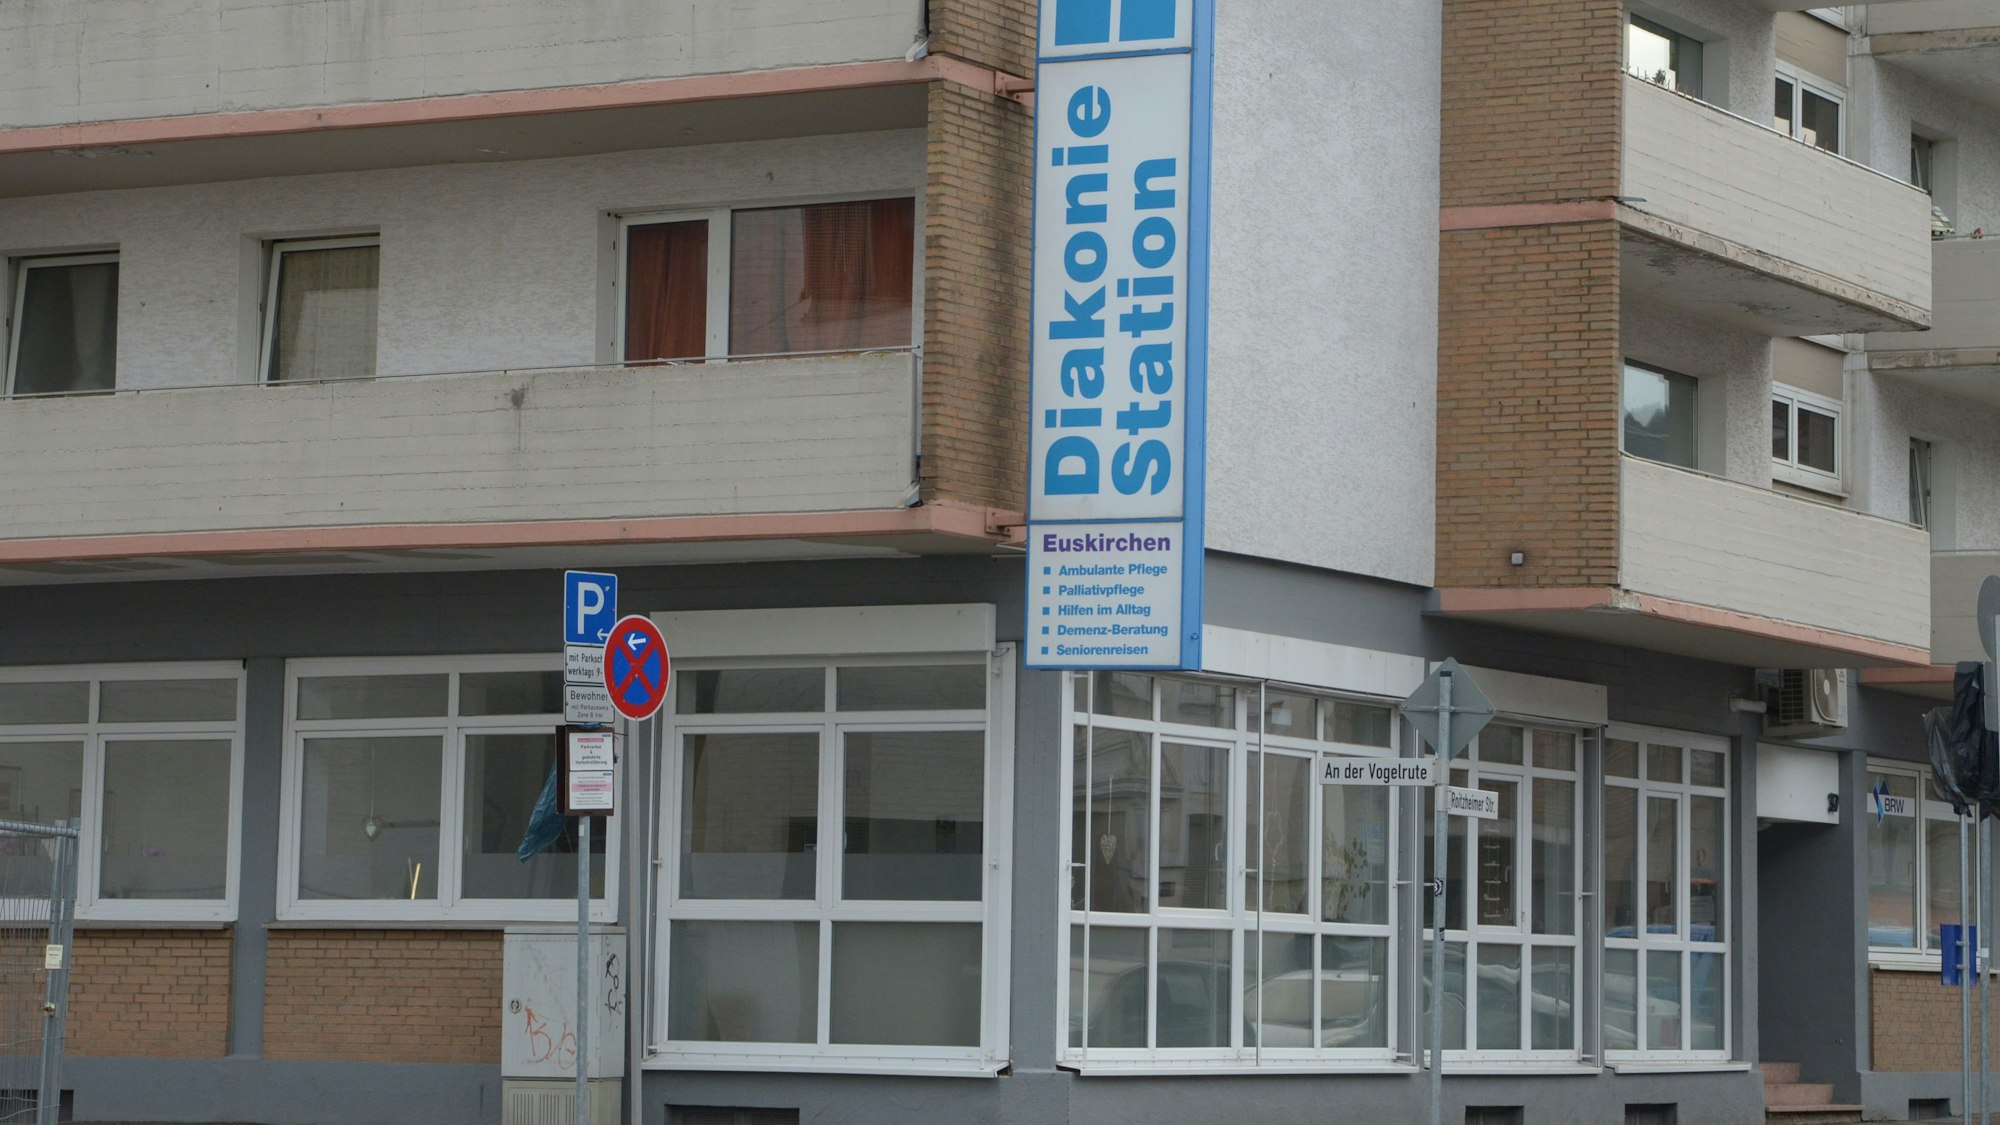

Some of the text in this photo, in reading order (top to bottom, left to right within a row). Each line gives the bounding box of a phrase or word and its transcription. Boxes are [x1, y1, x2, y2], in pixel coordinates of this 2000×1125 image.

[1043, 85, 1112, 496] Diakonie
[1111, 157, 1176, 496] Station
[1043, 533, 1171, 552] Euskirchen
[1058, 564, 1168, 577] Ambulante Pflege
[1058, 584, 1145, 597] Palliativpflege
[578, 582, 604, 634] P
[1058, 603, 1151, 617] Hilfen im Alltag
[1057, 624, 1168, 636] Demenz-Beratung
[1056, 644, 1149, 656] Seniorenreisen
[569, 653, 579, 662] mit
[568, 667, 594, 678] werktags
[1324, 763, 1427, 784] An der Vogelrute
[1451, 791, 1496, 814] Roitzheimer Str.
[1885, 798, 1904, 813] BRW
